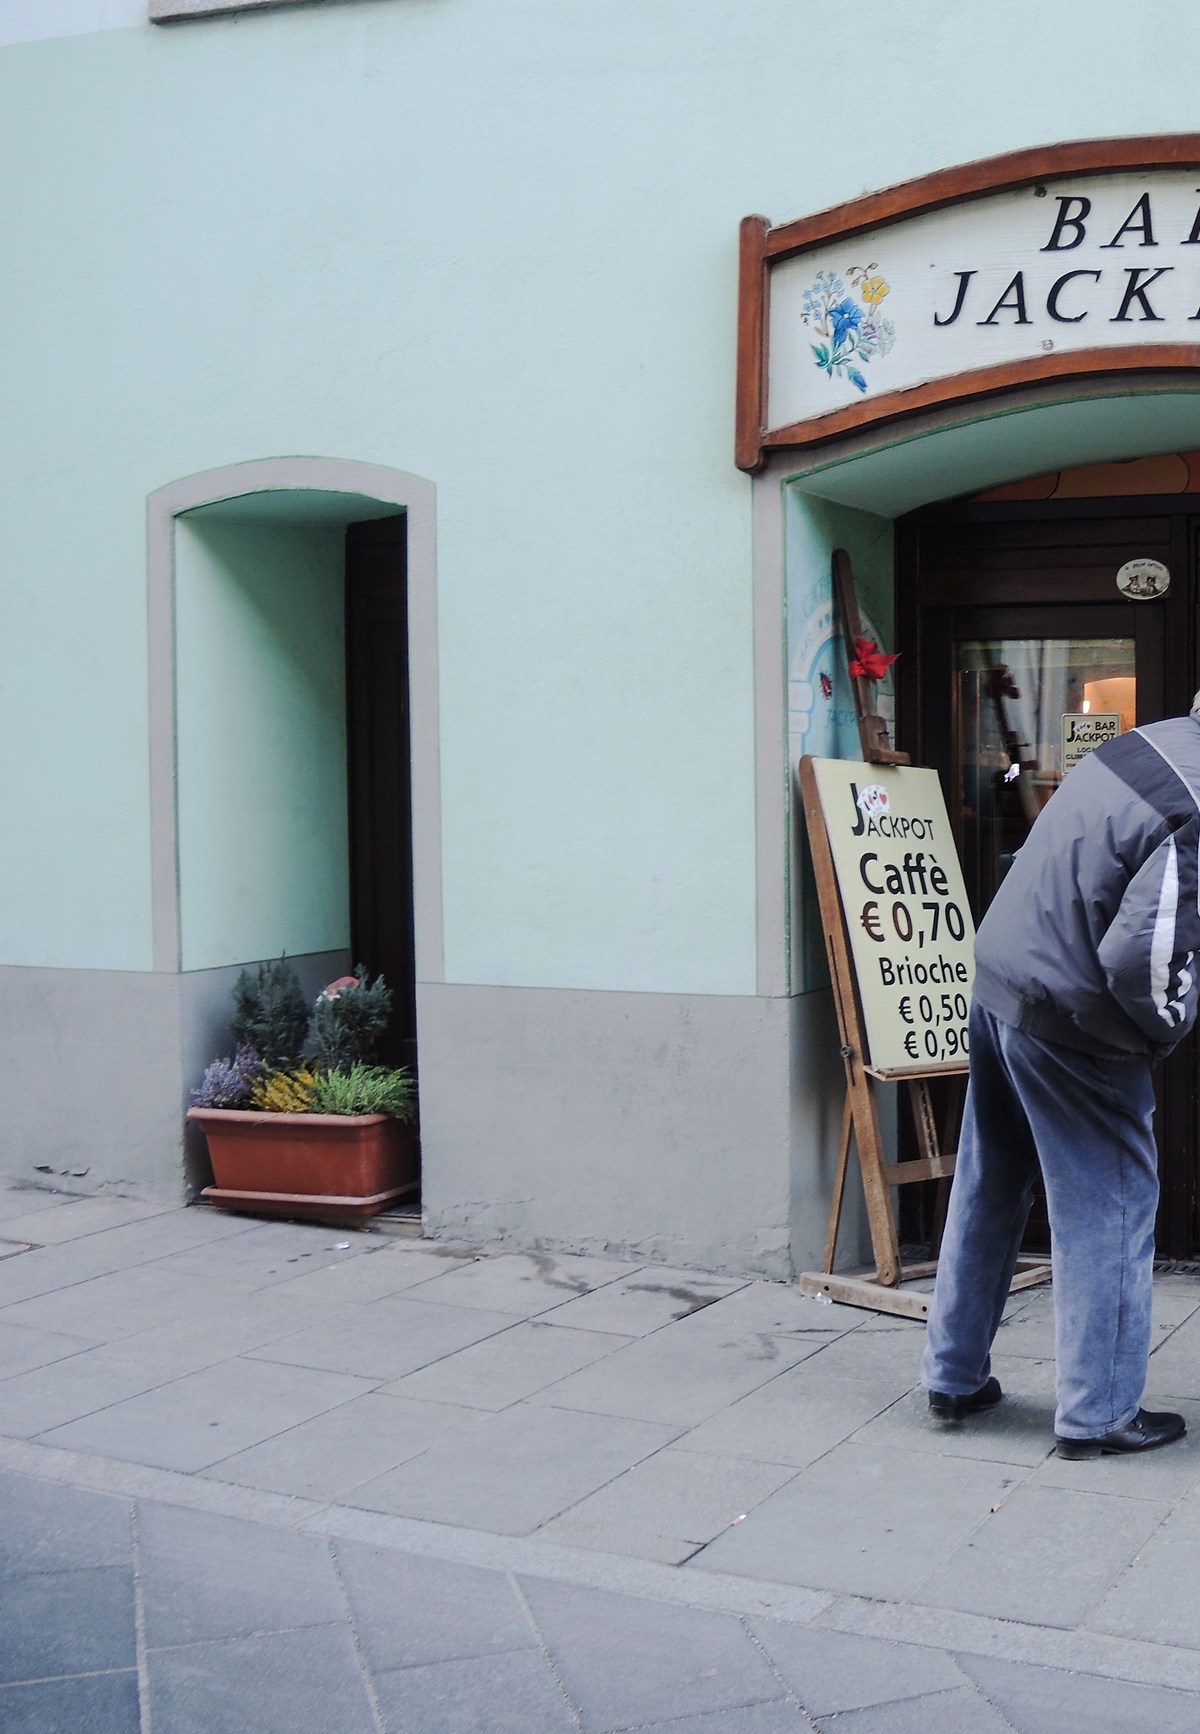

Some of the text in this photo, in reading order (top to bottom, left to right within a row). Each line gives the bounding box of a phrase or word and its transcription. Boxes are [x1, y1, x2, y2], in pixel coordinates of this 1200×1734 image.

[1066, 720, 1116, 743] JACKPOT
[1095, 721, 1116, 731] BAR
[849, 782, 934, 841] JACKPOT
[859, 852, 949, 896] Caffè
[892, 901, 966, 949] 0,70
[878, 954, 968, 986] Brioche
[919, 993, 967, 1027] 0,50
